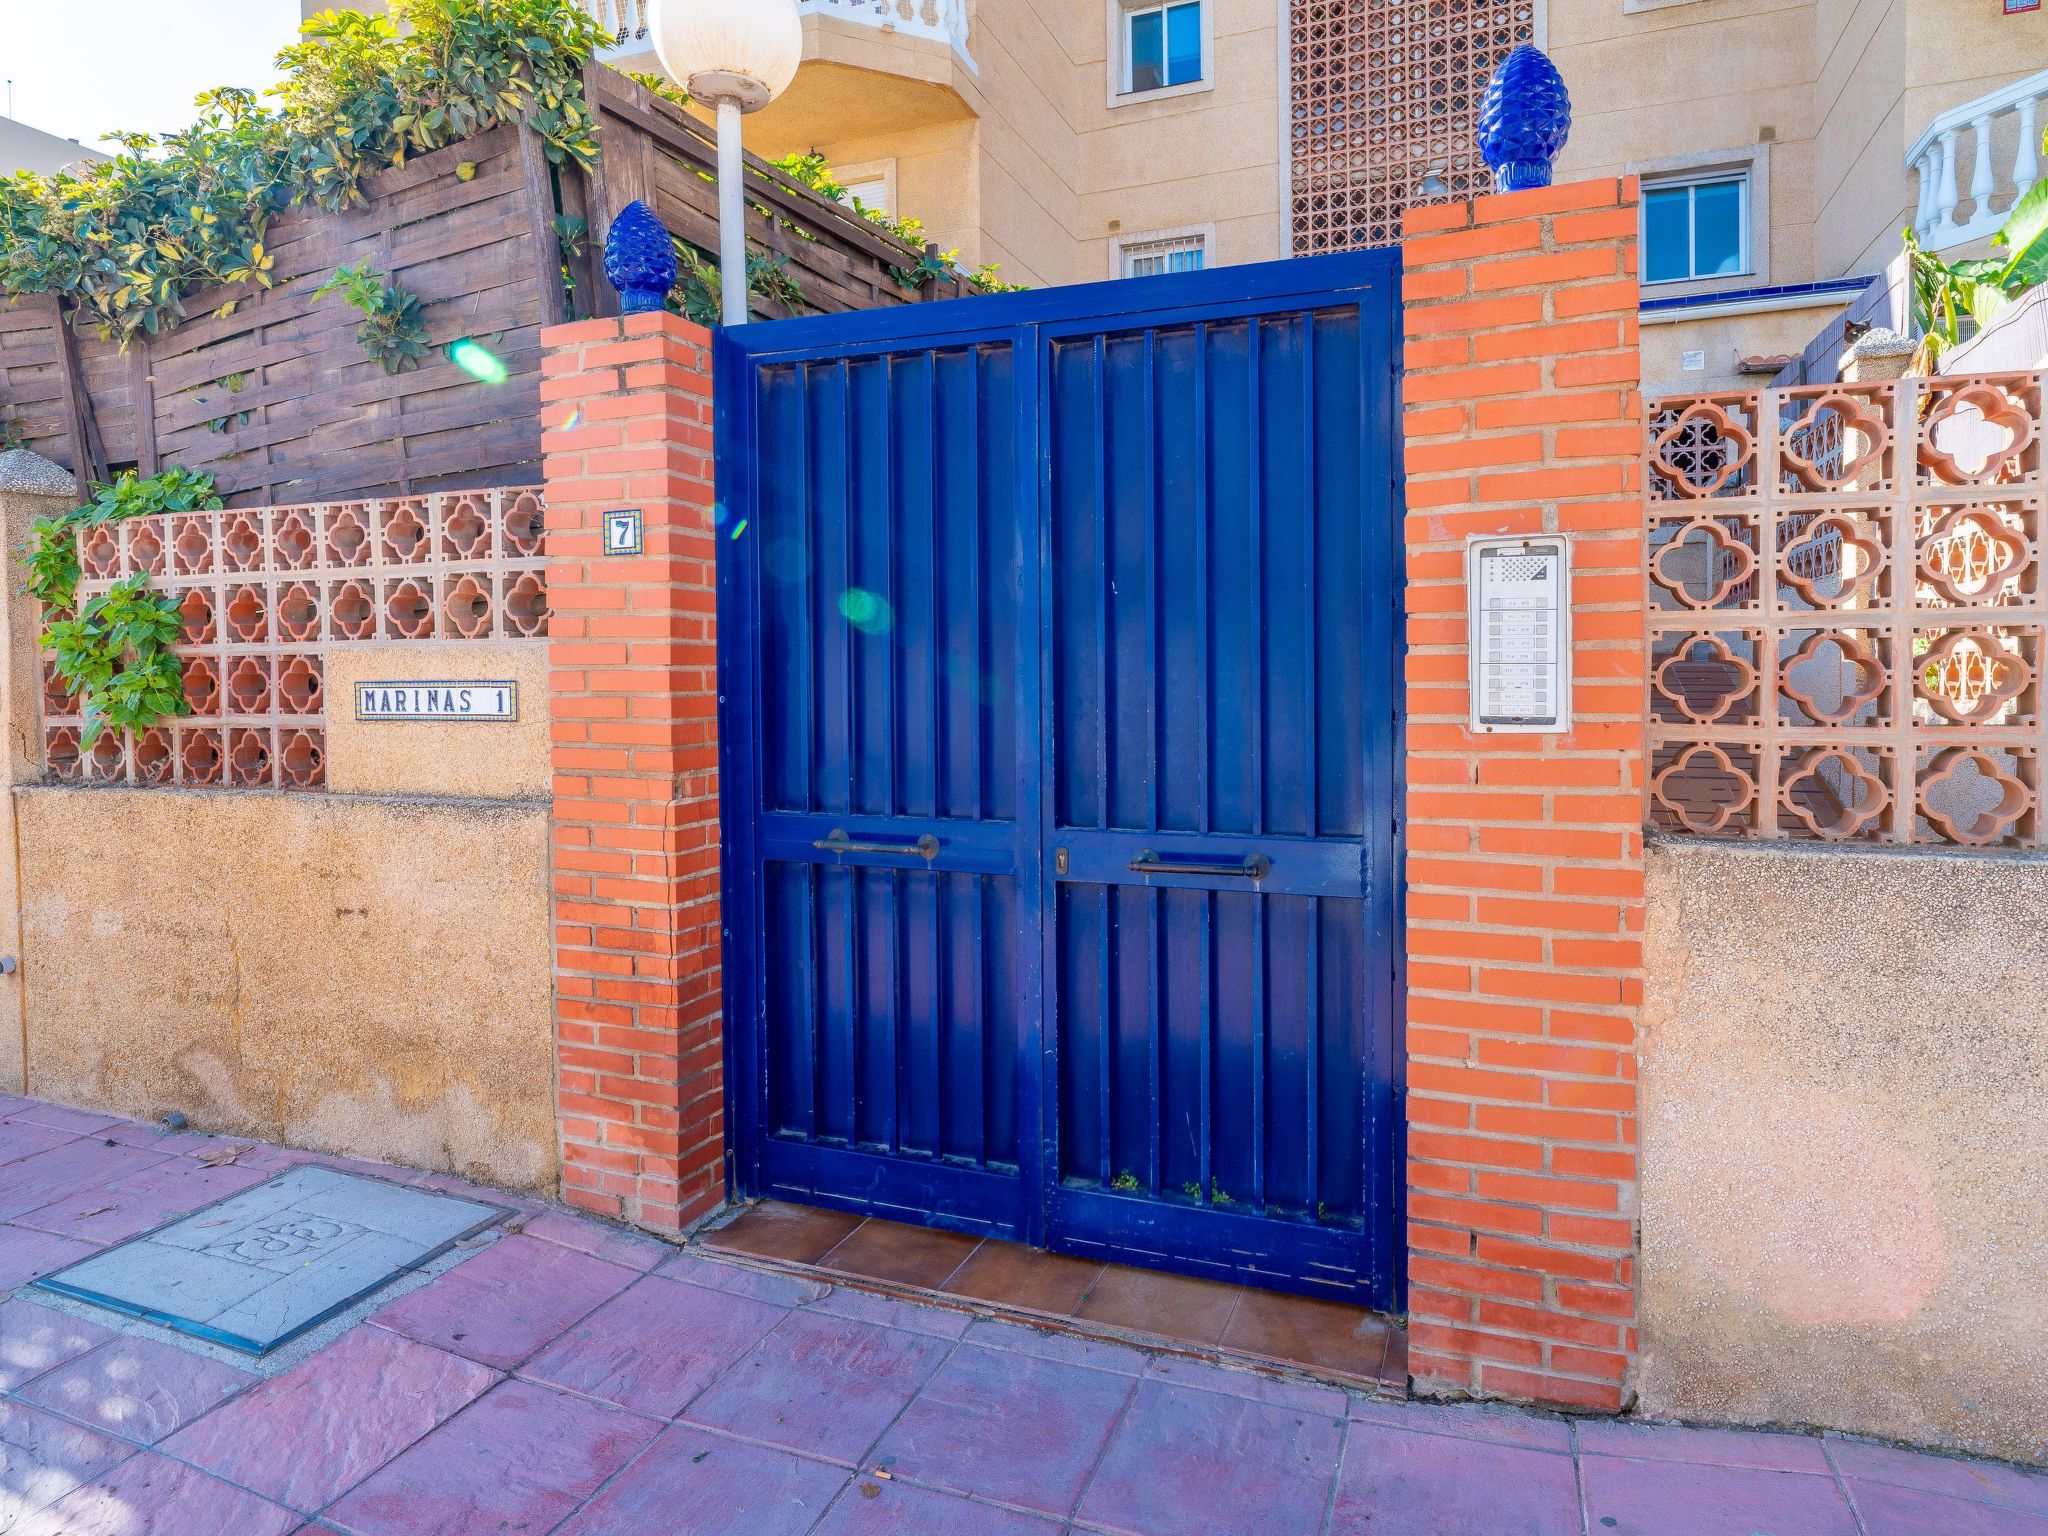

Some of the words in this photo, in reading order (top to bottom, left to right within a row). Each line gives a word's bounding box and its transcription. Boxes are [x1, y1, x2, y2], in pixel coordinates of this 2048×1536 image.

[615, 520, 630, 545] 7
[364, 689, 472, 713] MARINAS
[496, 690, 504, 713] 1
